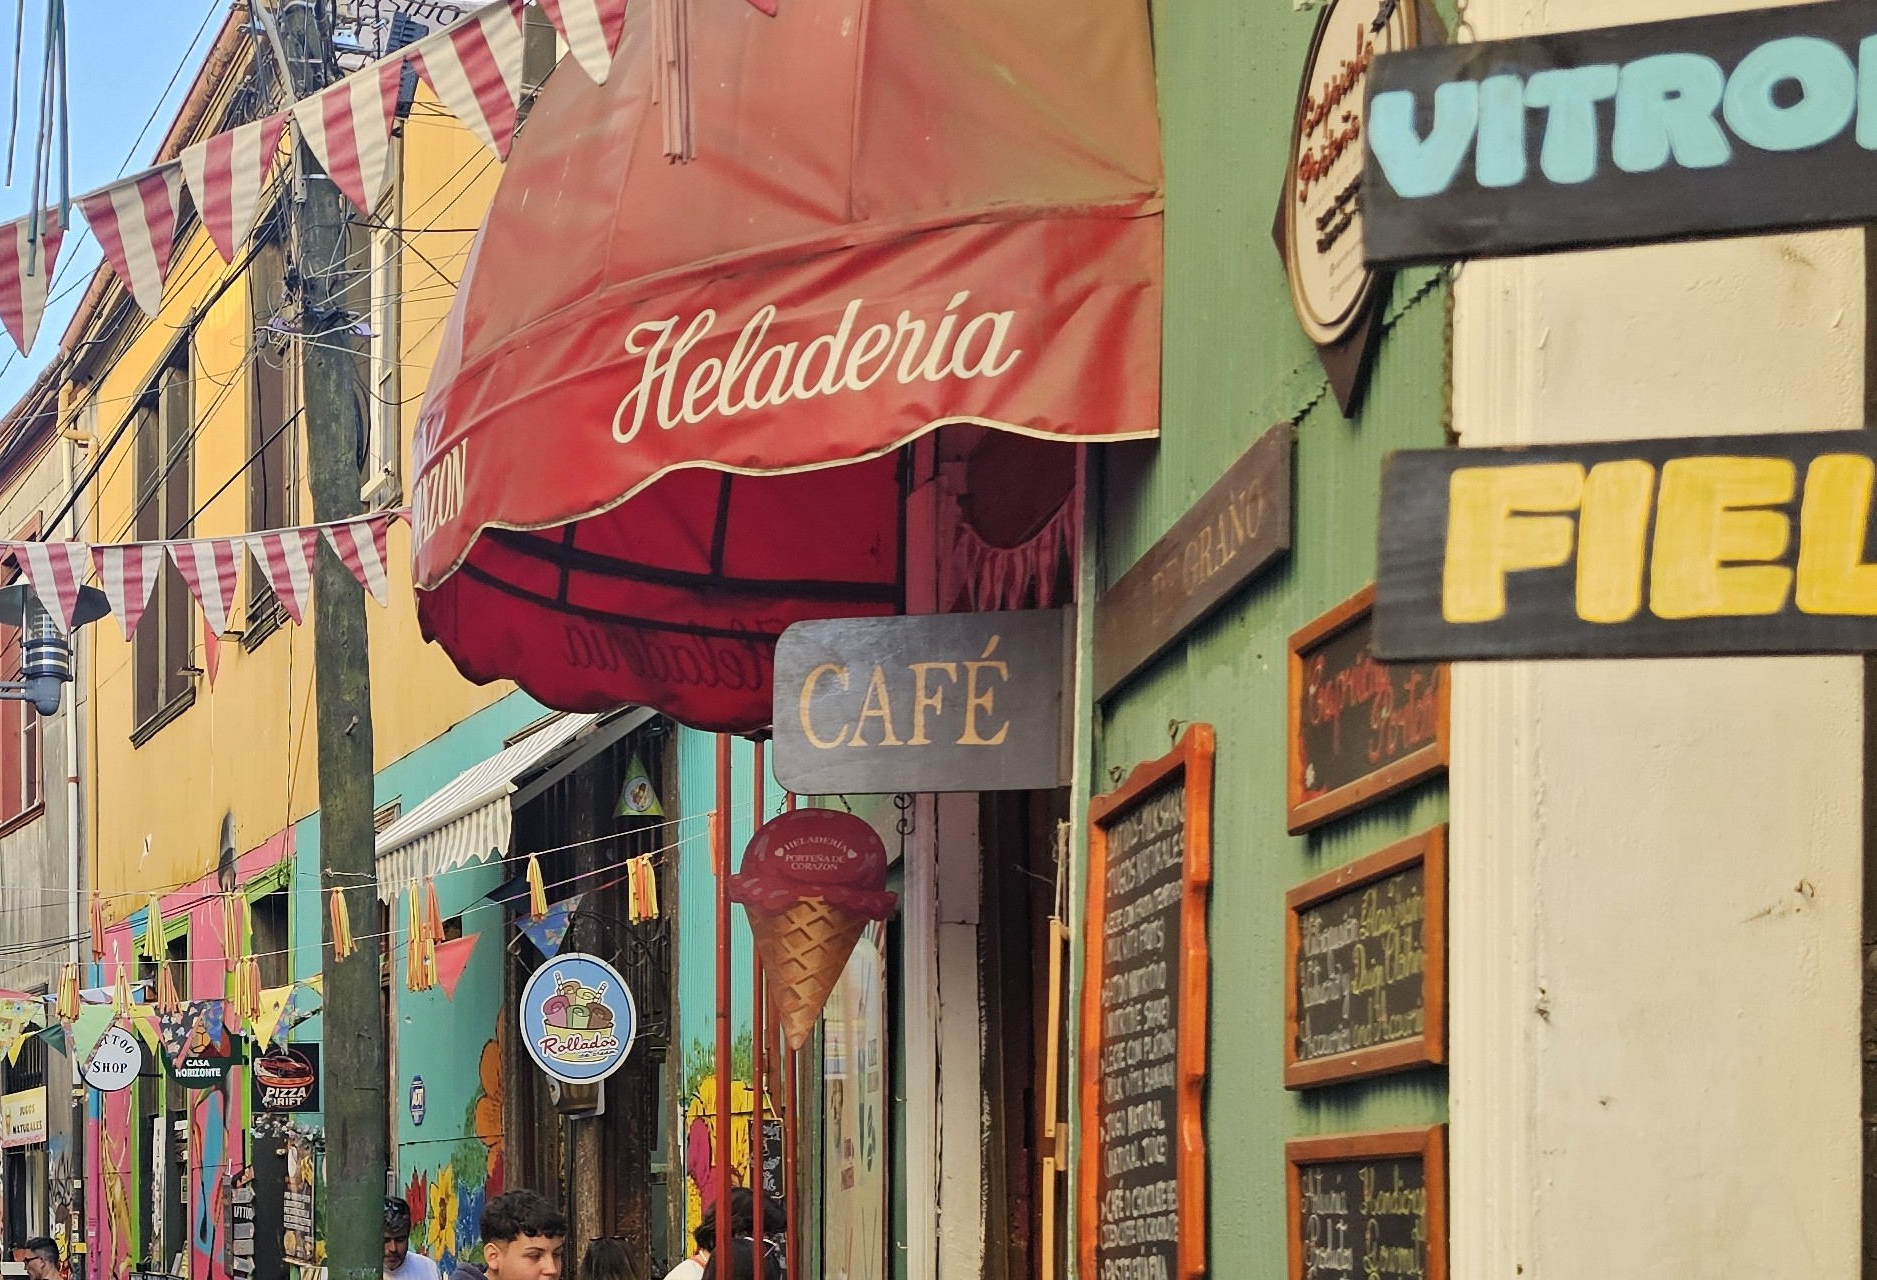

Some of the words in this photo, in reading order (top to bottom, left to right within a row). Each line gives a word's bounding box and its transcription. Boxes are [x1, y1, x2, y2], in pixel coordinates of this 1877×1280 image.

[1367, 36, 1877, 198] VITRO
[611, 290, 1022, 443] Heladería
[799, 635, 1011, 750] CAFÉ
[103, 1033, 135, 1054] TTOO
[539, 1033, 618, 1056] Rollados
[92, 1060, 128, 1074] SHOP
[185, 1059, 211, 1067] CASA
[175, 1067, 222, 1078] HORIZONTE
[266, 1086, 307, 1098] PIZZA
[12, 1119, 43, 1135] NATURALES
